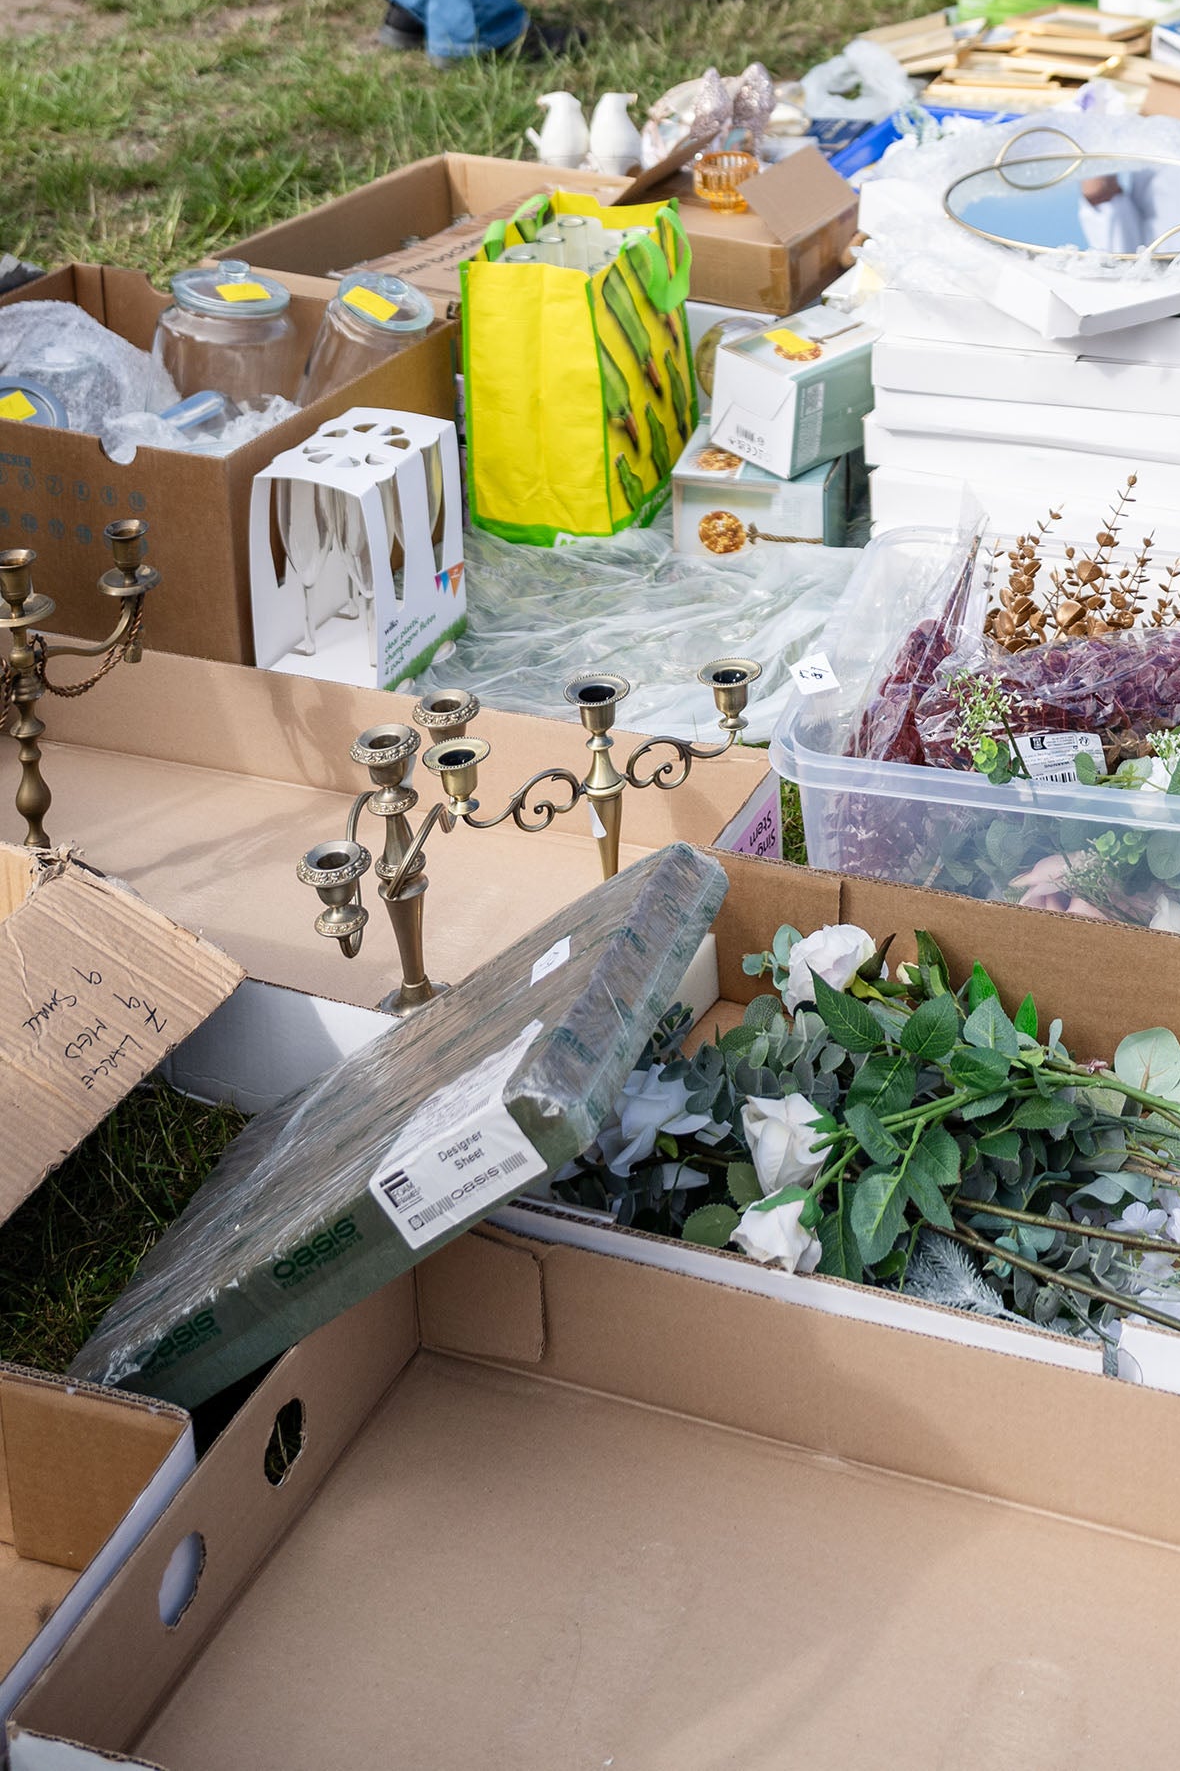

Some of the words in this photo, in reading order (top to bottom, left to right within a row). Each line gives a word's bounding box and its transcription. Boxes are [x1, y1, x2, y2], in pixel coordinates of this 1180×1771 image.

[749, 810, 773, 846] Stem
[754, 828, 776, 856] Sing
[22, 989, 76, 1036] SMALL
[142, 1000, 167, 1032] 7
[65, 1018, 107, 1058] MED
[81, 1034, 143, 1090] LARGE
[436, 1129, 482, 1162] Designer
[453, 1146, 485, 1170] Sheet
